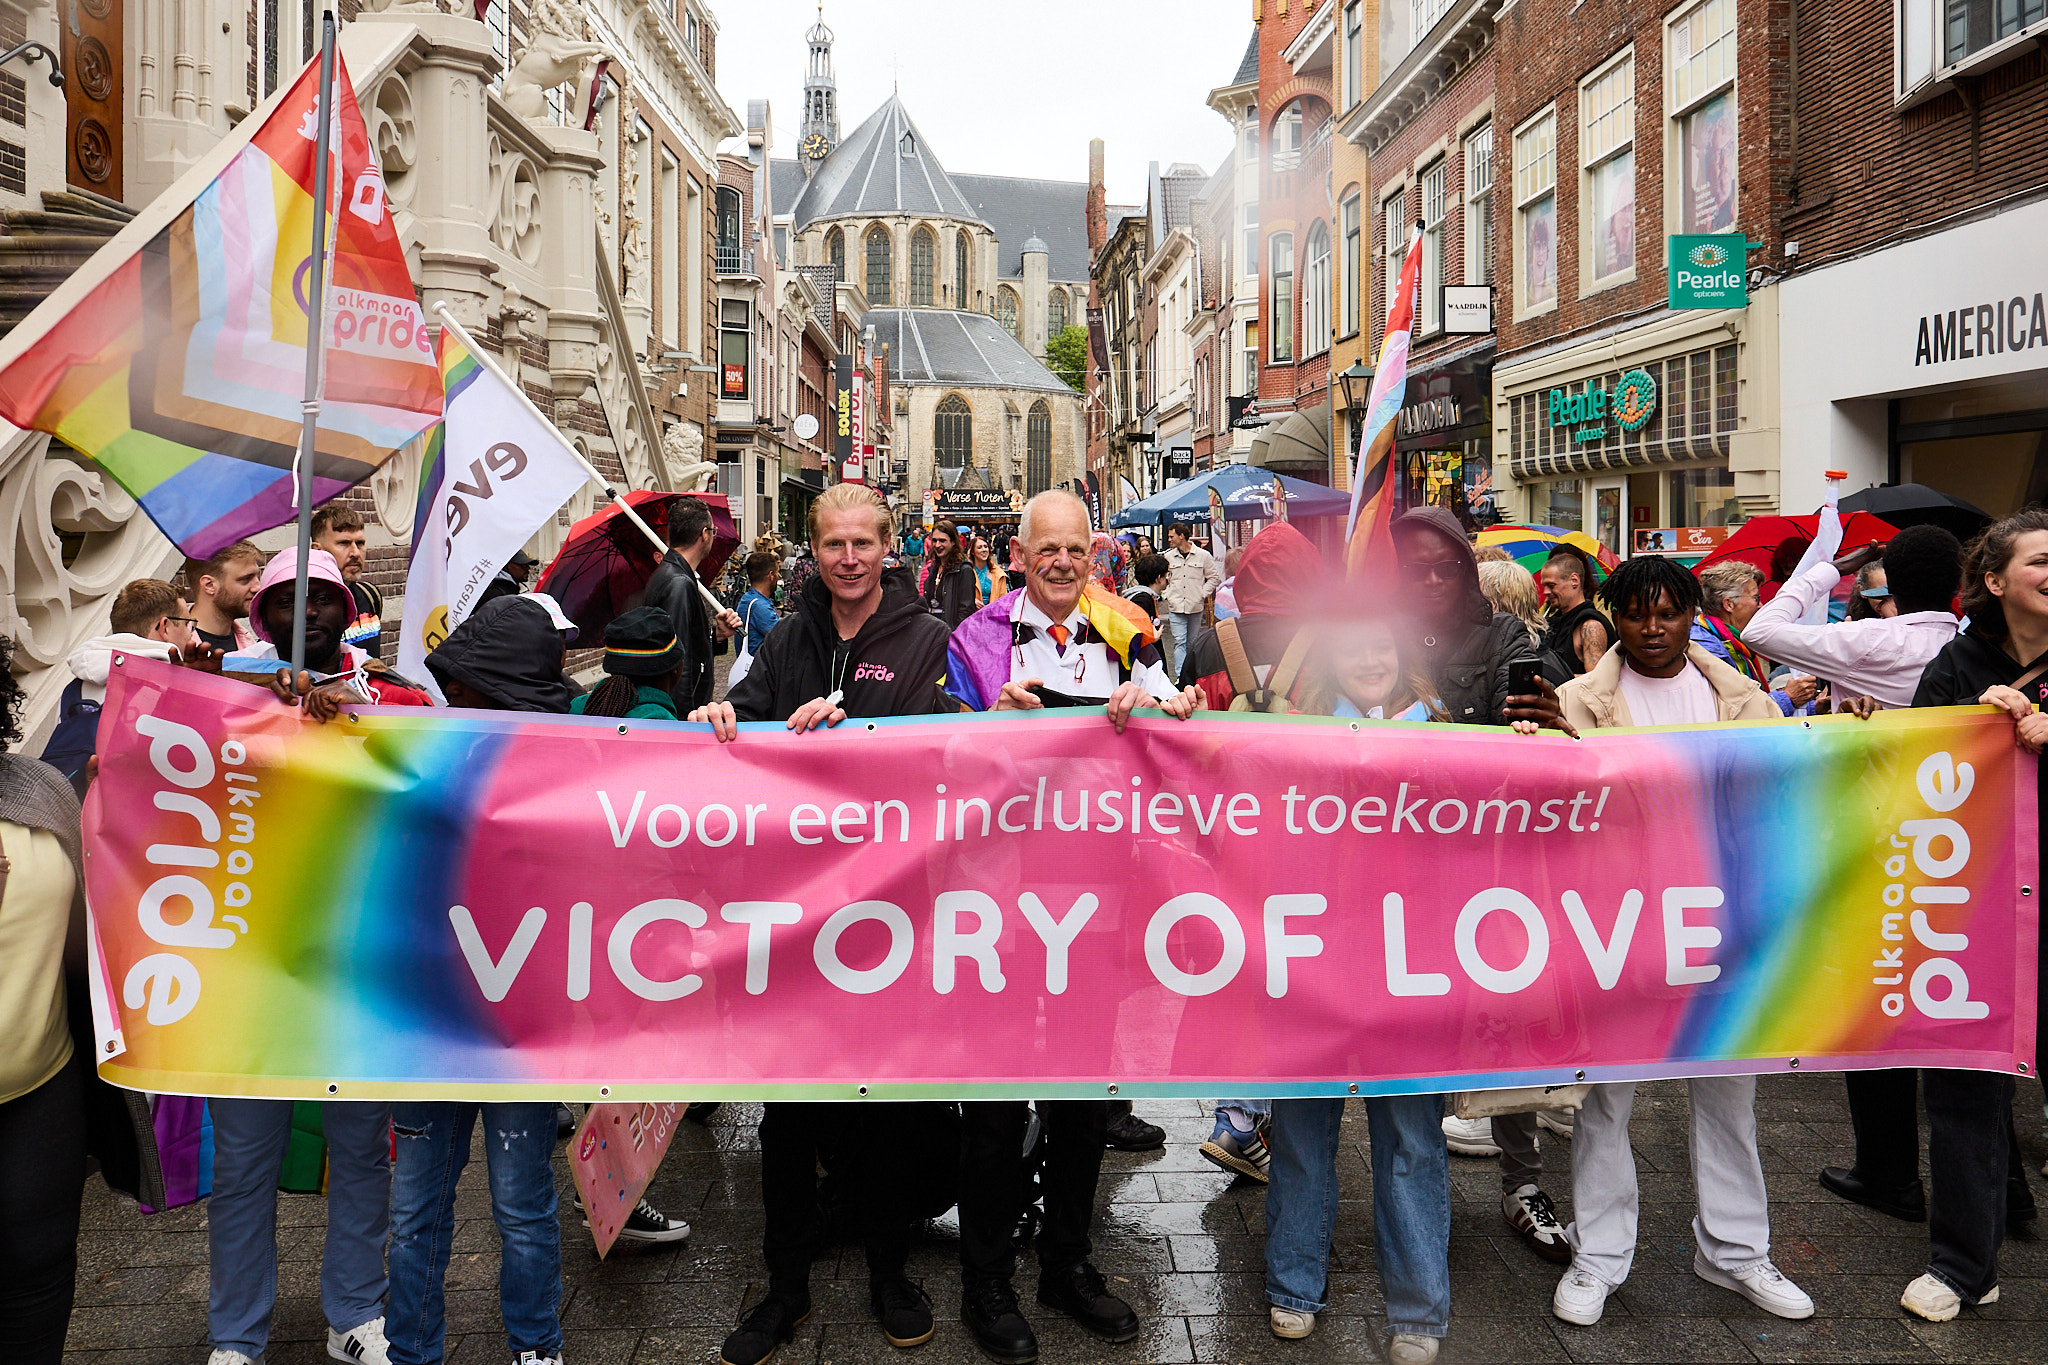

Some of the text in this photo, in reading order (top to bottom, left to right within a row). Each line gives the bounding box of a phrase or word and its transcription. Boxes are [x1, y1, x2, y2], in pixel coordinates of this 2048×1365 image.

[1677, 270, 1741, 289] Pearle
[337, 293, 411, 317] alkmaar
[333, 310, 431, 354] pride
[1914, 292, 2048, 367] AMERICA
[725, 371, 743, 384] 50%
[838, 388, 851, 437] xenos
[1549, 379, 1607, 428] Pearle
[1173, 450, 1190, 458] back
[1574, 426, 1608, 445] opticiens
[943, 490, 1005, 503] Verse Noten
[1688, 532, 1714, 545] Sun
[854, 667, 895, 682] pride
[596, 776, 1610, 849] Voor een inclusieve toekomst!
[220, 739, 262, 935] alkmaar
[123, 713, 236, 1026] pride
[1909, 751, 1990, 1020] pride
[448, 886, 1726, 1003] VICTORY OF LOVE
[1872, 833, 1909, 1018] alkmaar
